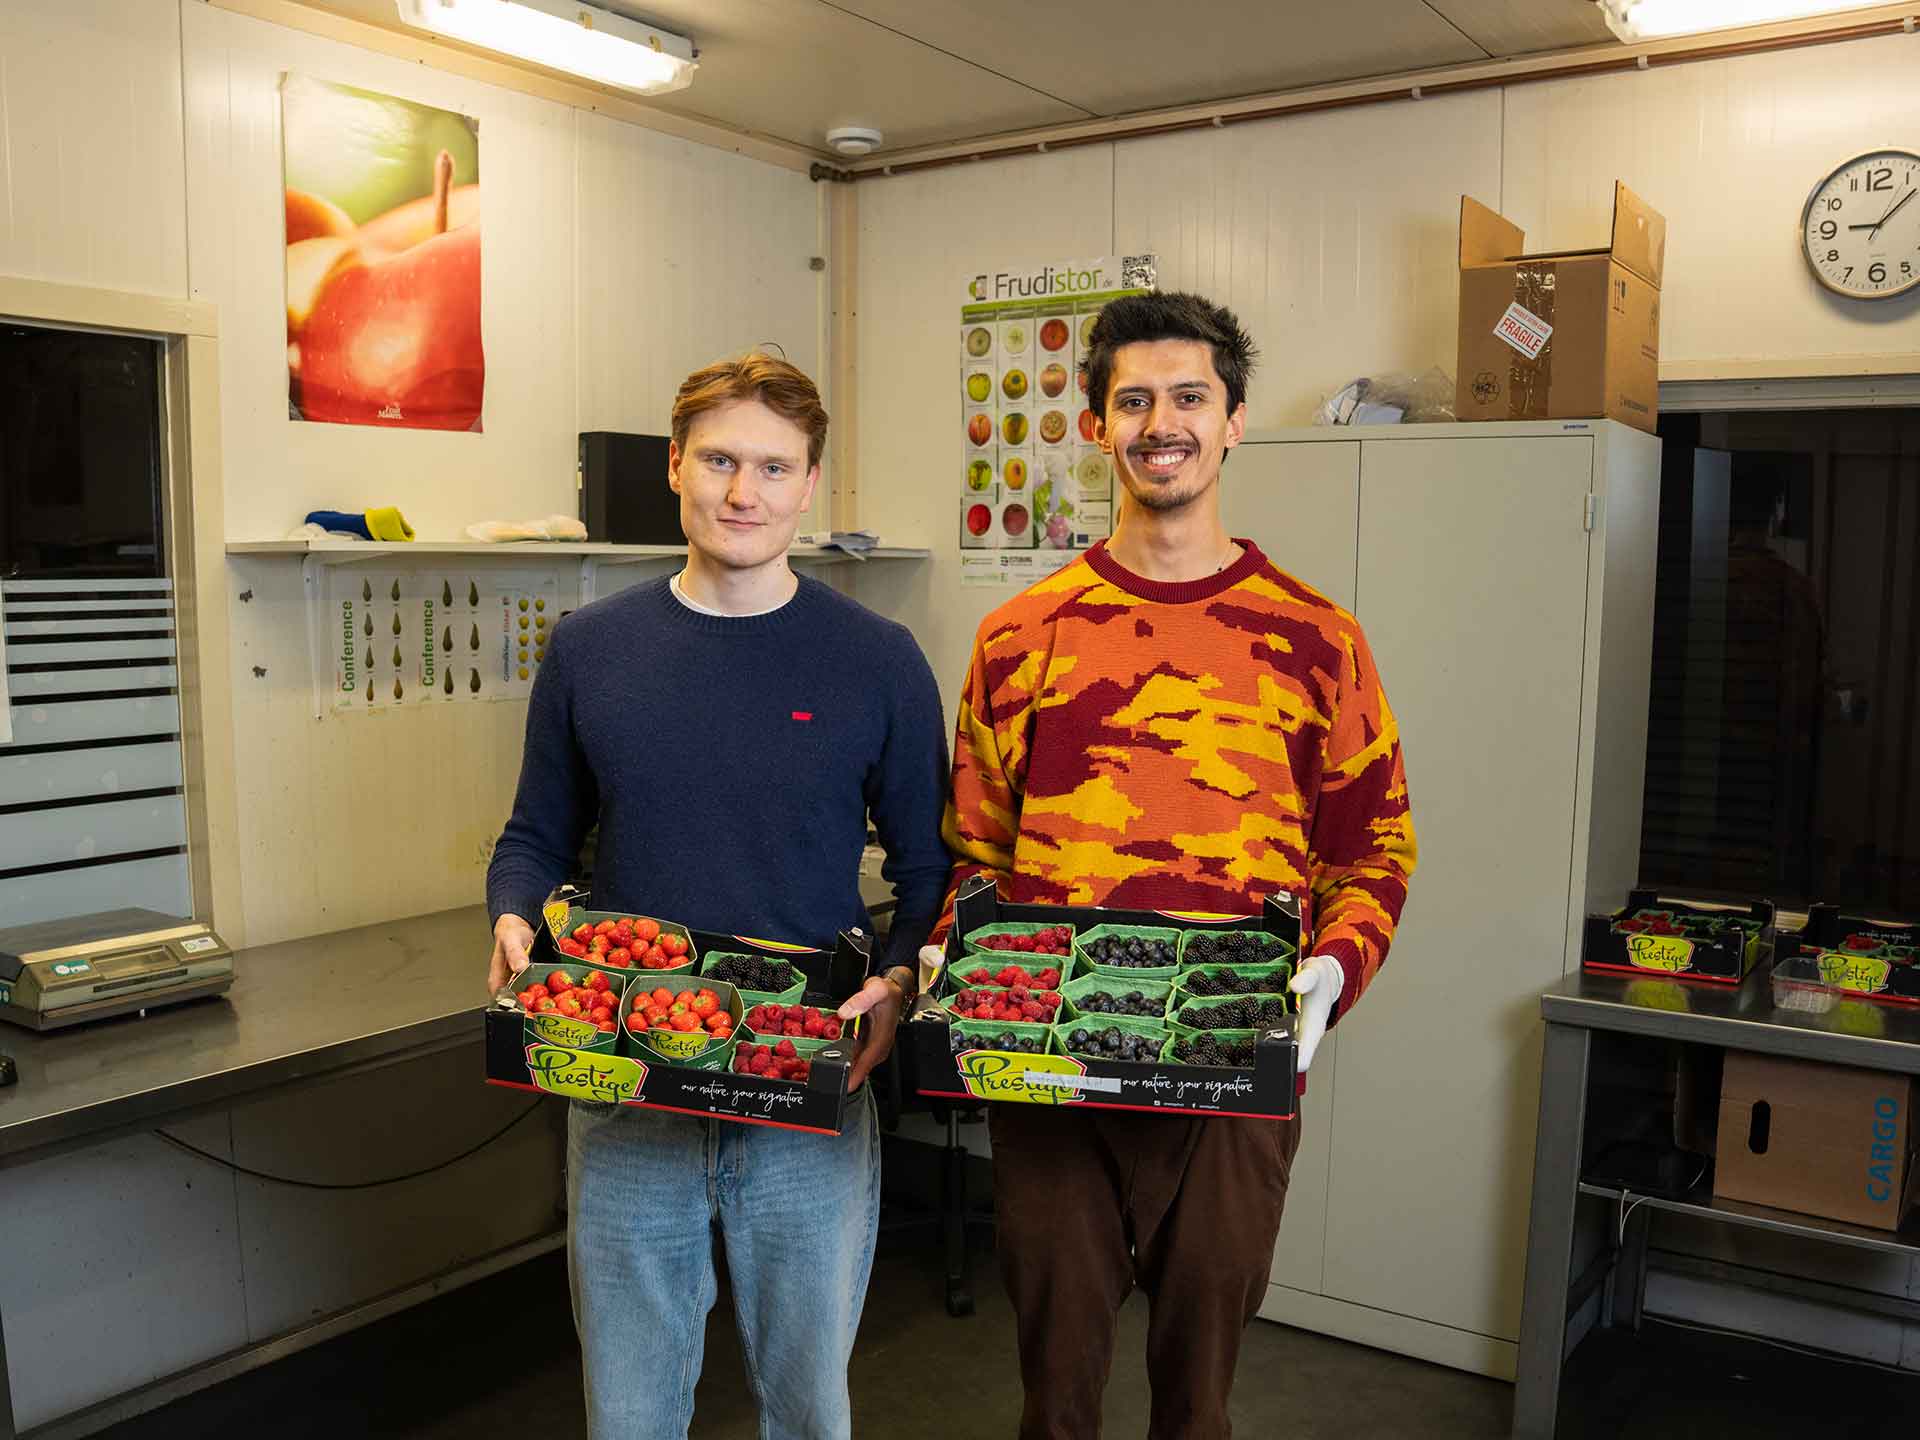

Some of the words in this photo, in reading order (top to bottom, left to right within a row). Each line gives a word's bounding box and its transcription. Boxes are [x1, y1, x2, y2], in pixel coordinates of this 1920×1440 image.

[1850, 178, 1858, 192] 11
[1866, 168, 1894, 192] 12
[1827, 198, 1842, 212] 10
[1819, 220, 1838, 241] 9
[1826, 249, 1840, 262] 8
[1900, 261, 1911, 274] 5
[1842, 266, 1854, 284] 7
[1868, 262, 1887, 283] 6
[1500, 317, 1542, 352] FRAGILE
[341, 600, 354, 692] Conference
[422, 599, 434, 687] Conference
[1628, 936, 1693, 973] Prestige
[535, 1015, 597, 1047] Prestige
[526, 1049, 645, 1104] Prestige
[1122, 1079, 1140, 1087] our
[1176, 1079, 1202, 1099] your
[1203, 1075, 1254, 1103] signature
[681, 1084, 697, 1092] our
[732, 1089, 756, 1107] your
[758, 1087, 804, 1113] signature
[1866, 1097, 1899, 1202] CARGO
